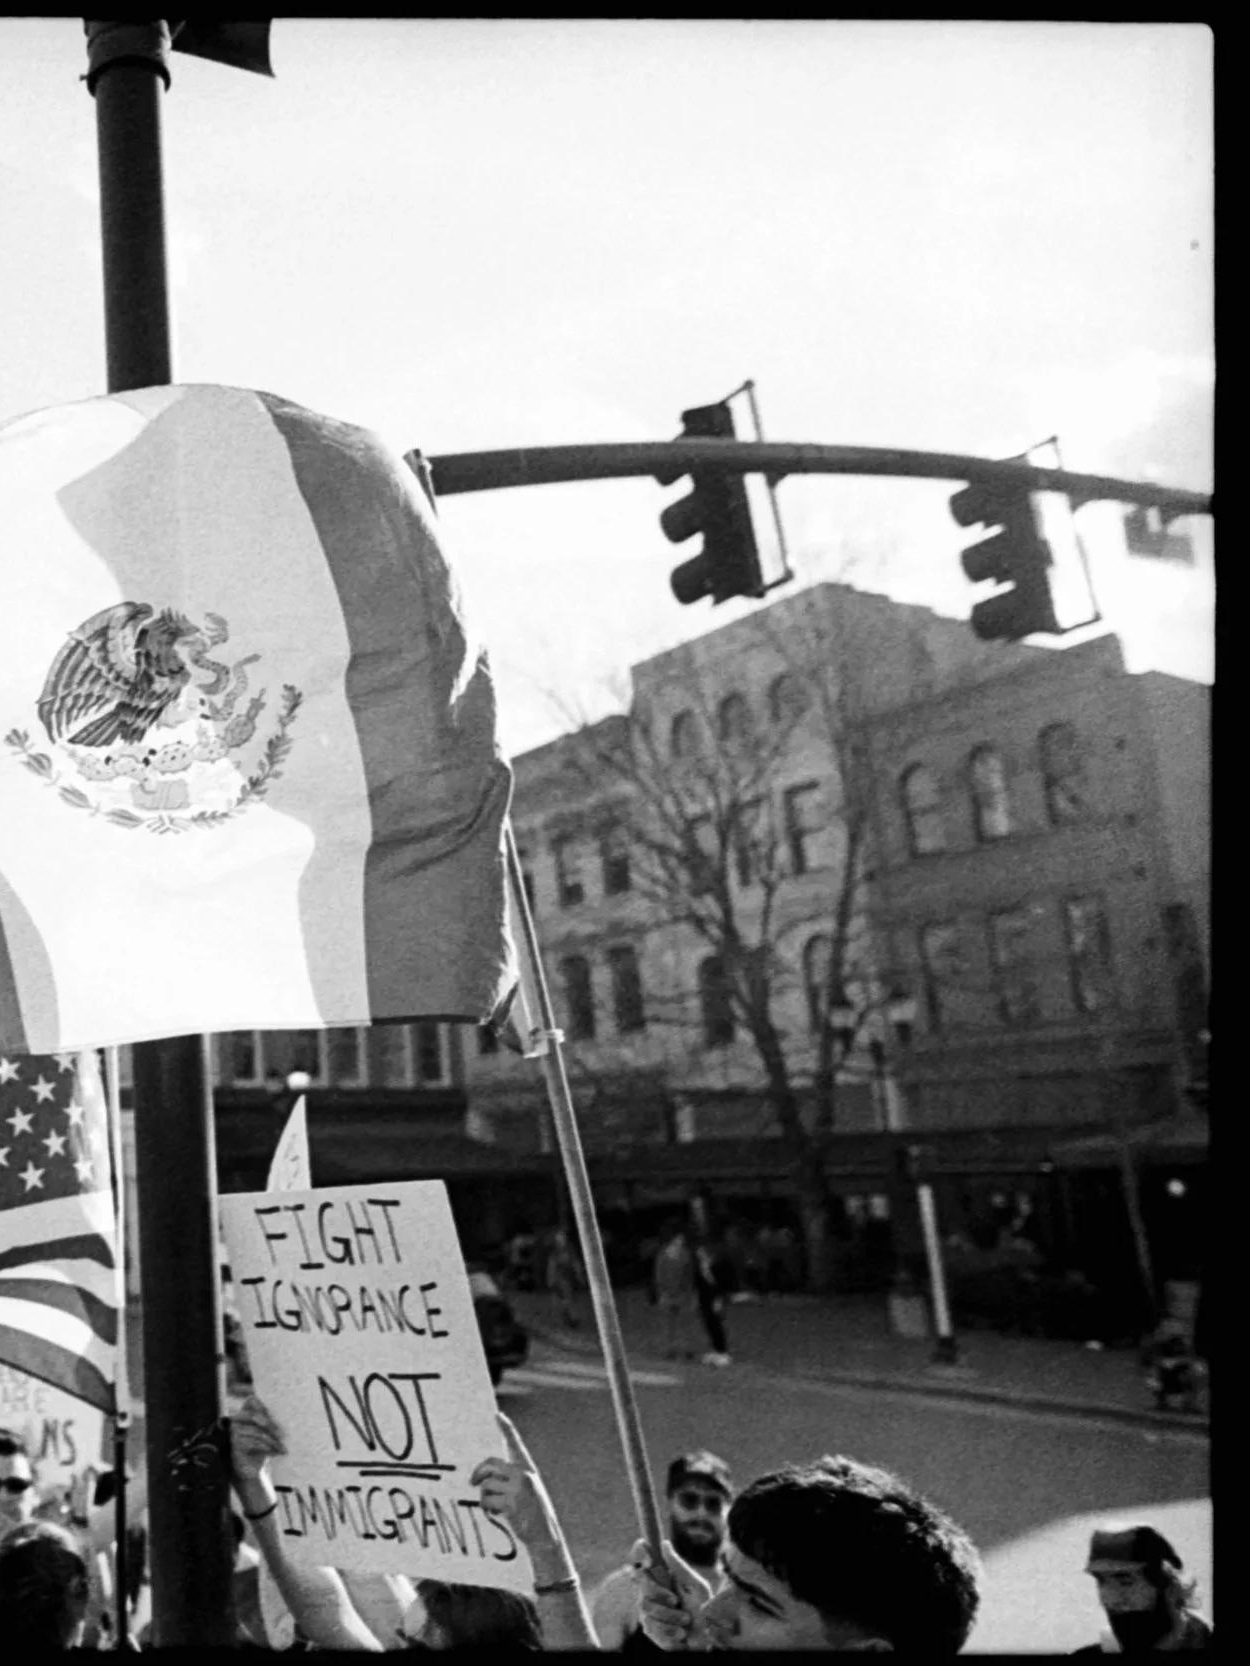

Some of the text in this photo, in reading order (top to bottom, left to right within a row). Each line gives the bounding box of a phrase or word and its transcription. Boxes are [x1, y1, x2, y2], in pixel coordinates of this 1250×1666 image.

[254, 1198, 401, 1270] FIGHT
[241, 1277, 449, 1338] IGNORANCE
[317, 1372, 441, 1464] NOT
[274, 1485, 517, 1561] IMMIGRANTS
